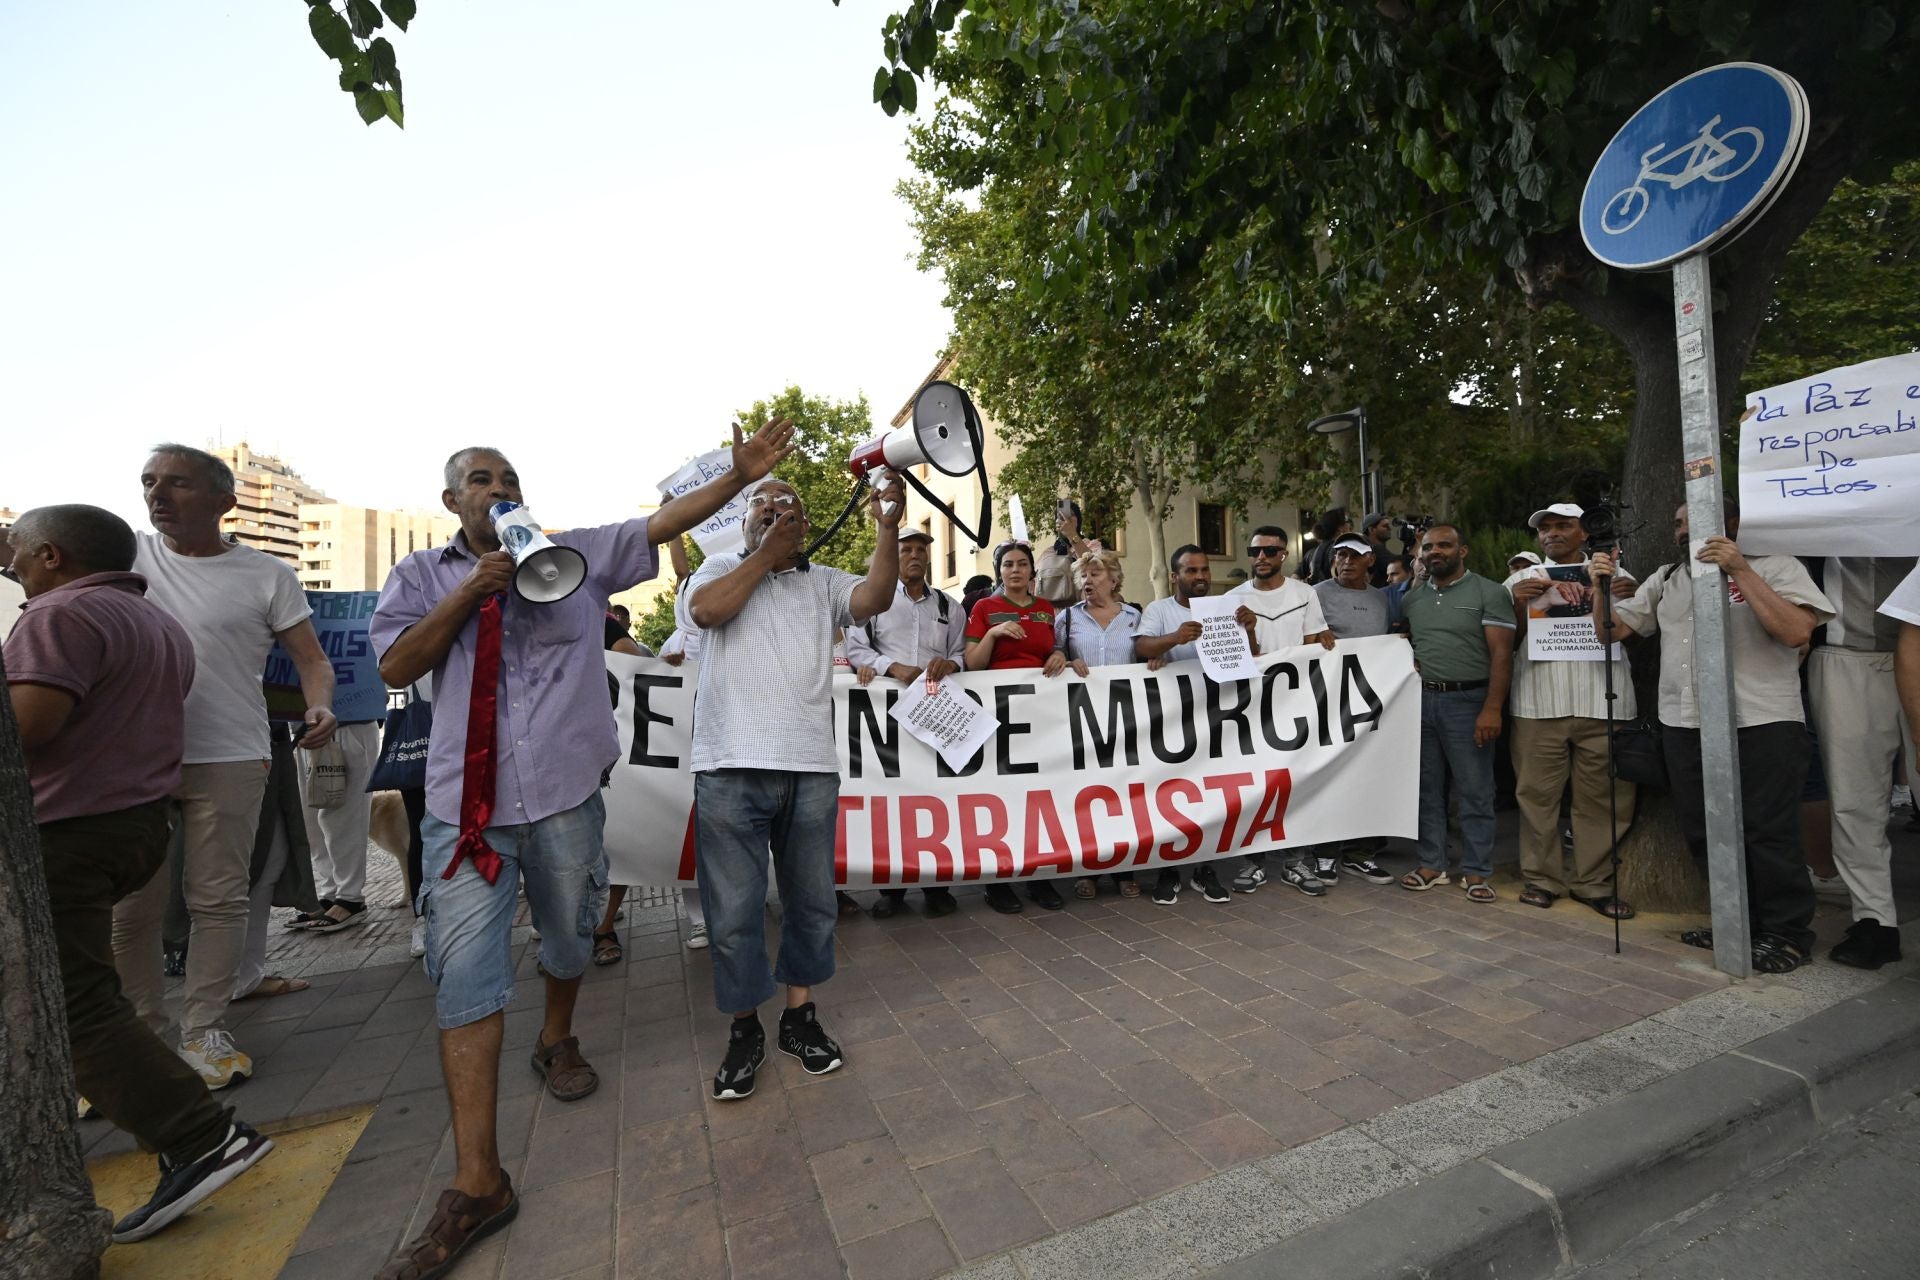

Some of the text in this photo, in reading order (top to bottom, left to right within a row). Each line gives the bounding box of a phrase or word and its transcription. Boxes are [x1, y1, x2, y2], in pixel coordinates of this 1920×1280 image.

[1805, 383, 1872, 414] Paz
[1815, 450, 1857, 472] De
[1202, 632, 1217, 640] QUE
[1201, 638, 1243, 649] LA OSCURIDAD
[1554, 644, 1606, 652] HUMANIDAD
[1203, 645, 1246, 656] TODOS SOMOS
[1222, 653, 1242, 662] MISMO
[942, 691, 950, 699] DE
[1067, 653, 1384, 771] MURCIA
[677, 767, 1293, 885] TIRRACISTA
